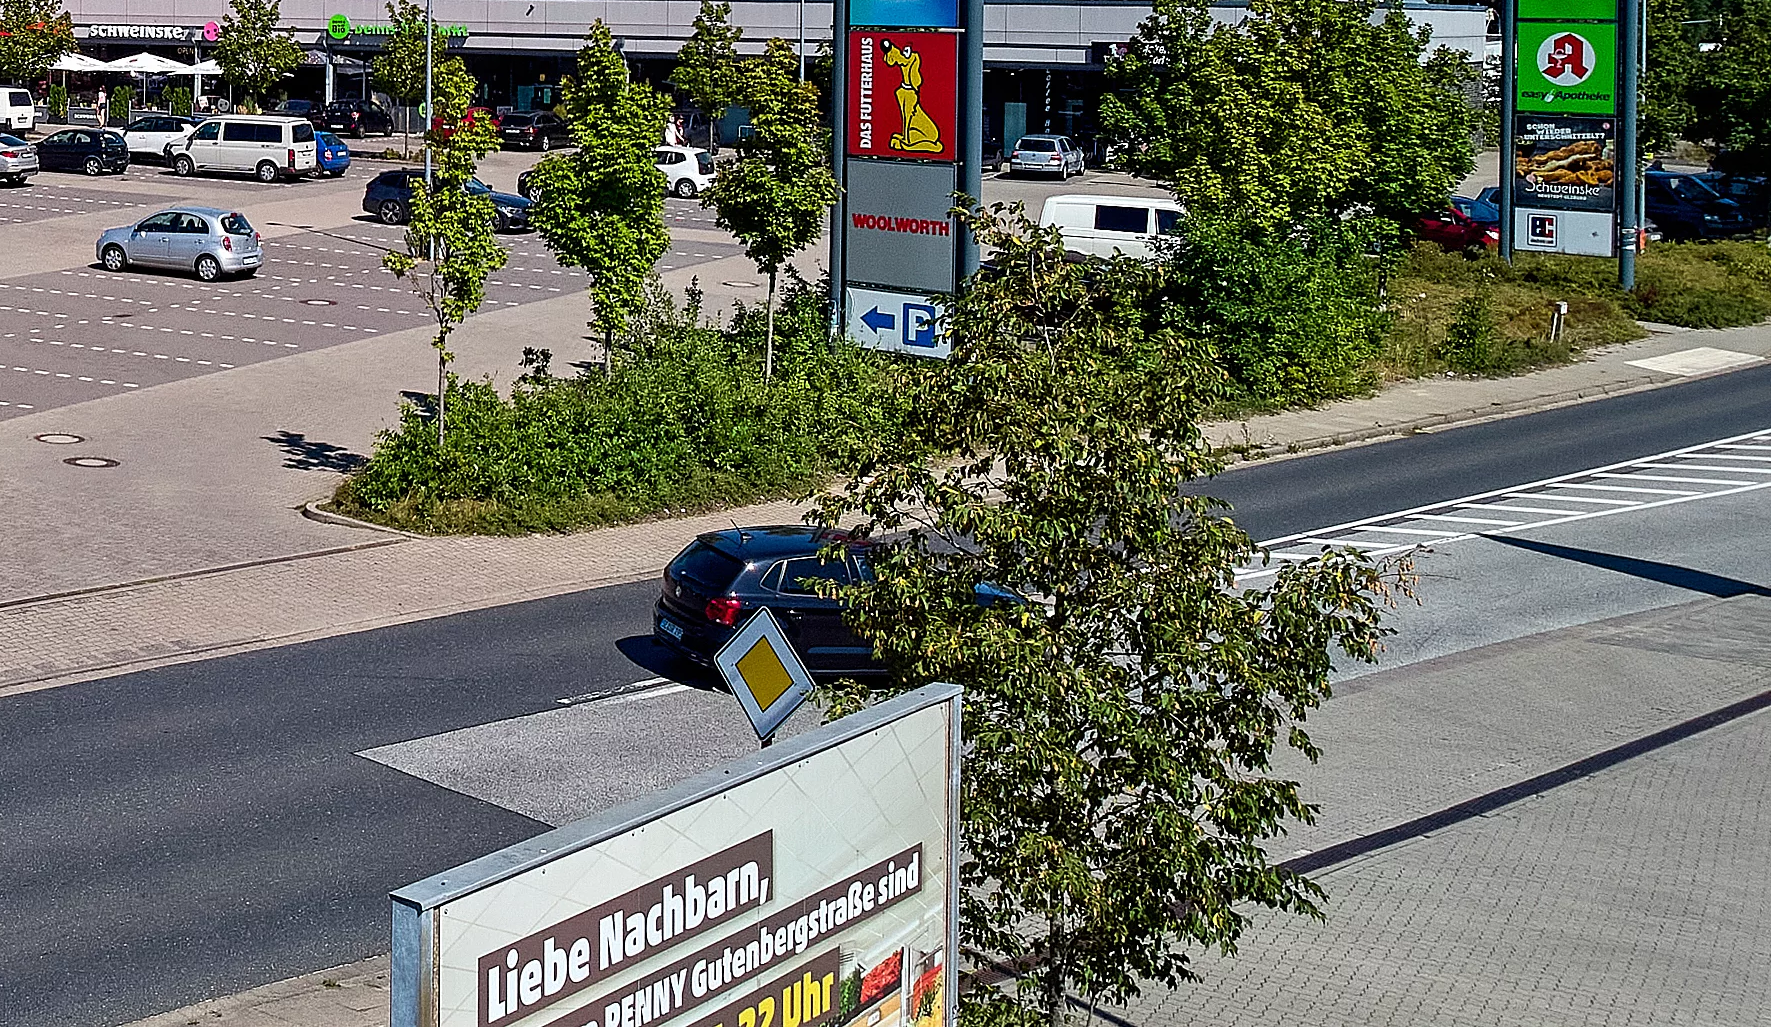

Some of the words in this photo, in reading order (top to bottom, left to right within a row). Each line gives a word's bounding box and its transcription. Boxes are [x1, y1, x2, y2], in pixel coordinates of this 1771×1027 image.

[860, 37, 873, 121] FUTTERHAUS
[859, 122, 872, 149] DAS
[1525, 180, 1601, 196] Schweinske
[851, 213, 950, 237] WOOLWORTH
[908, 308, 931, 341] P
[487, 934, 590, 1024] Liebe
[598, 860, 770, 971] Nachbarn,
[604, 969, 688, 1027] PENNY
[691, 882, 876, 999] Gutenbergstraße
[877, 852, 920, 902] sind
[783, 972, 834, 1027] Uhr
